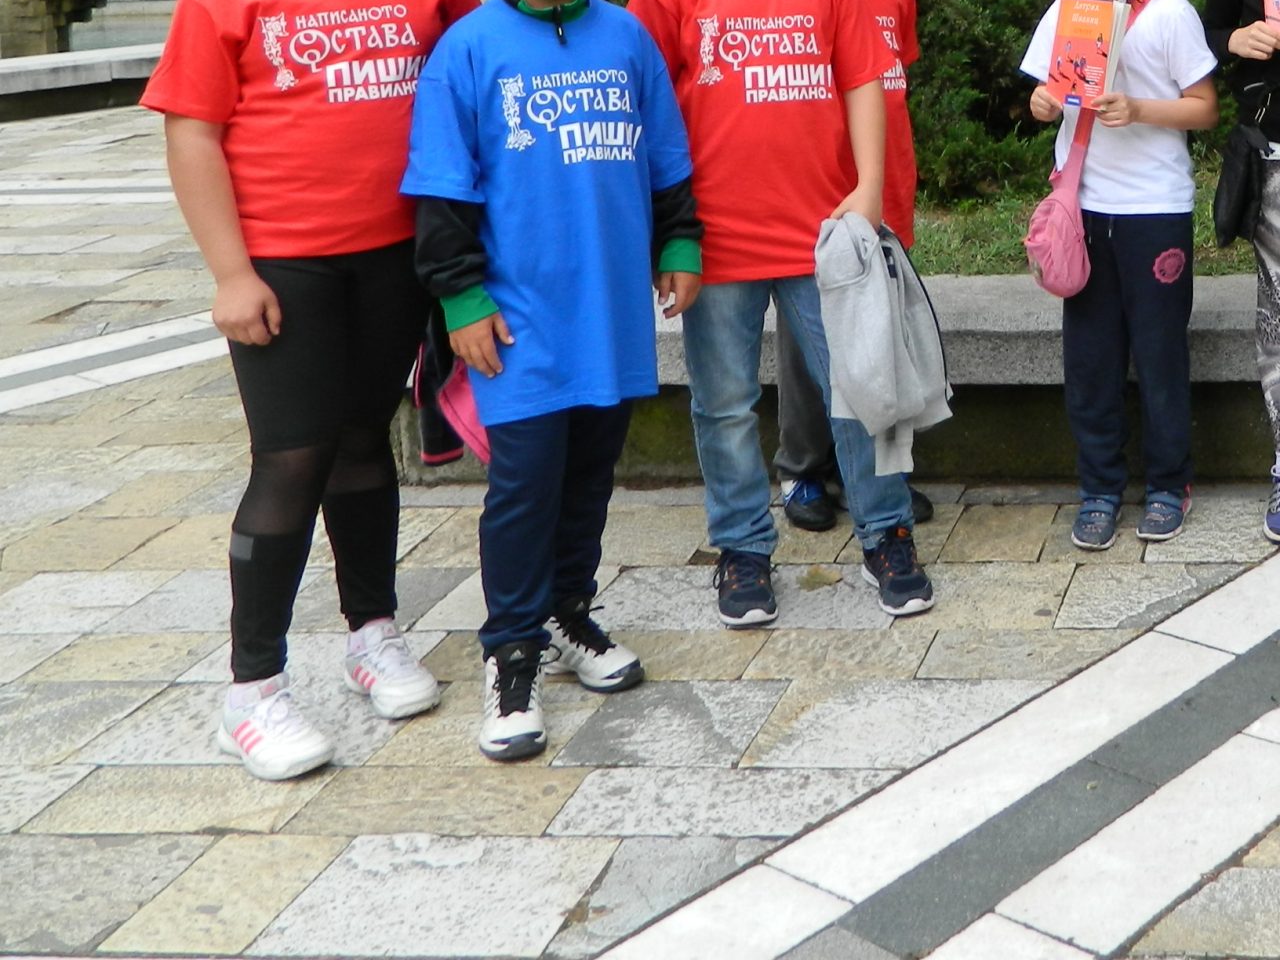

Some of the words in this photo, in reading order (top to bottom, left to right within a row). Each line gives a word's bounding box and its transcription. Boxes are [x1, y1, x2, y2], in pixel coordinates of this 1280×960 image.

[295, 4, 407, 30] НАПИСАНОТО
[726, 15, 814, 31] НАПИСАНОТО
[531, 69, 628, 90] НАПИСАНОТО
